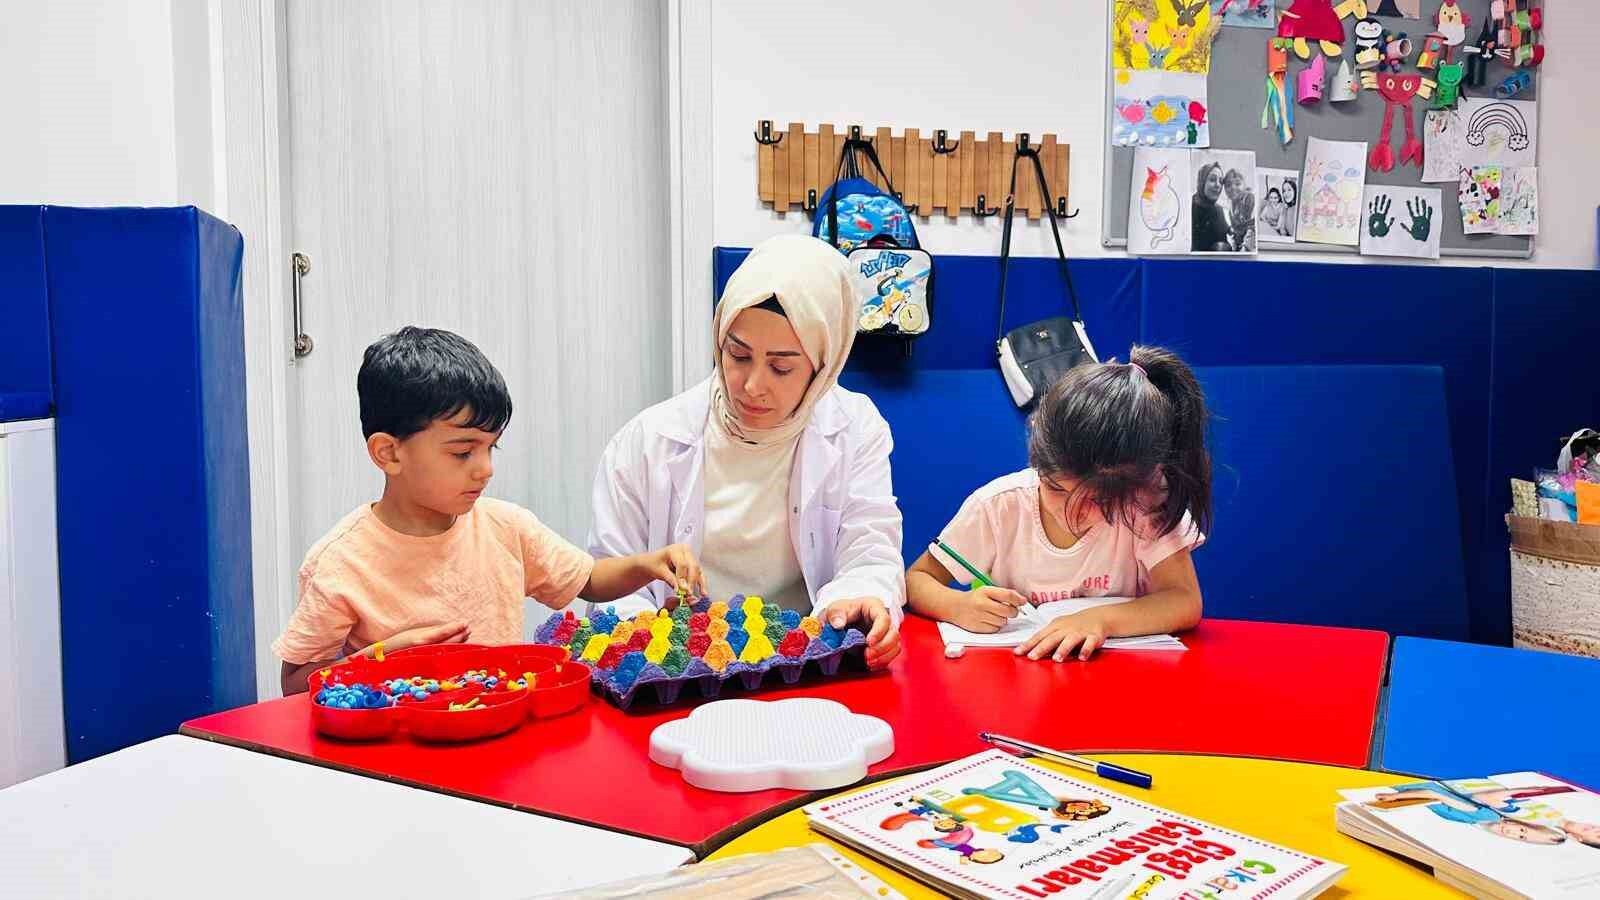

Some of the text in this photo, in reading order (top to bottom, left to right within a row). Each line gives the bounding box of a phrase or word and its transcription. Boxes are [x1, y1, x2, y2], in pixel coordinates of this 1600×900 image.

[1030, 574, 1111, 603] ADVENURE
[1014, 818, 1203, 898] Çalışmaları
[1142, 837, 1237, 880] Çizgi
